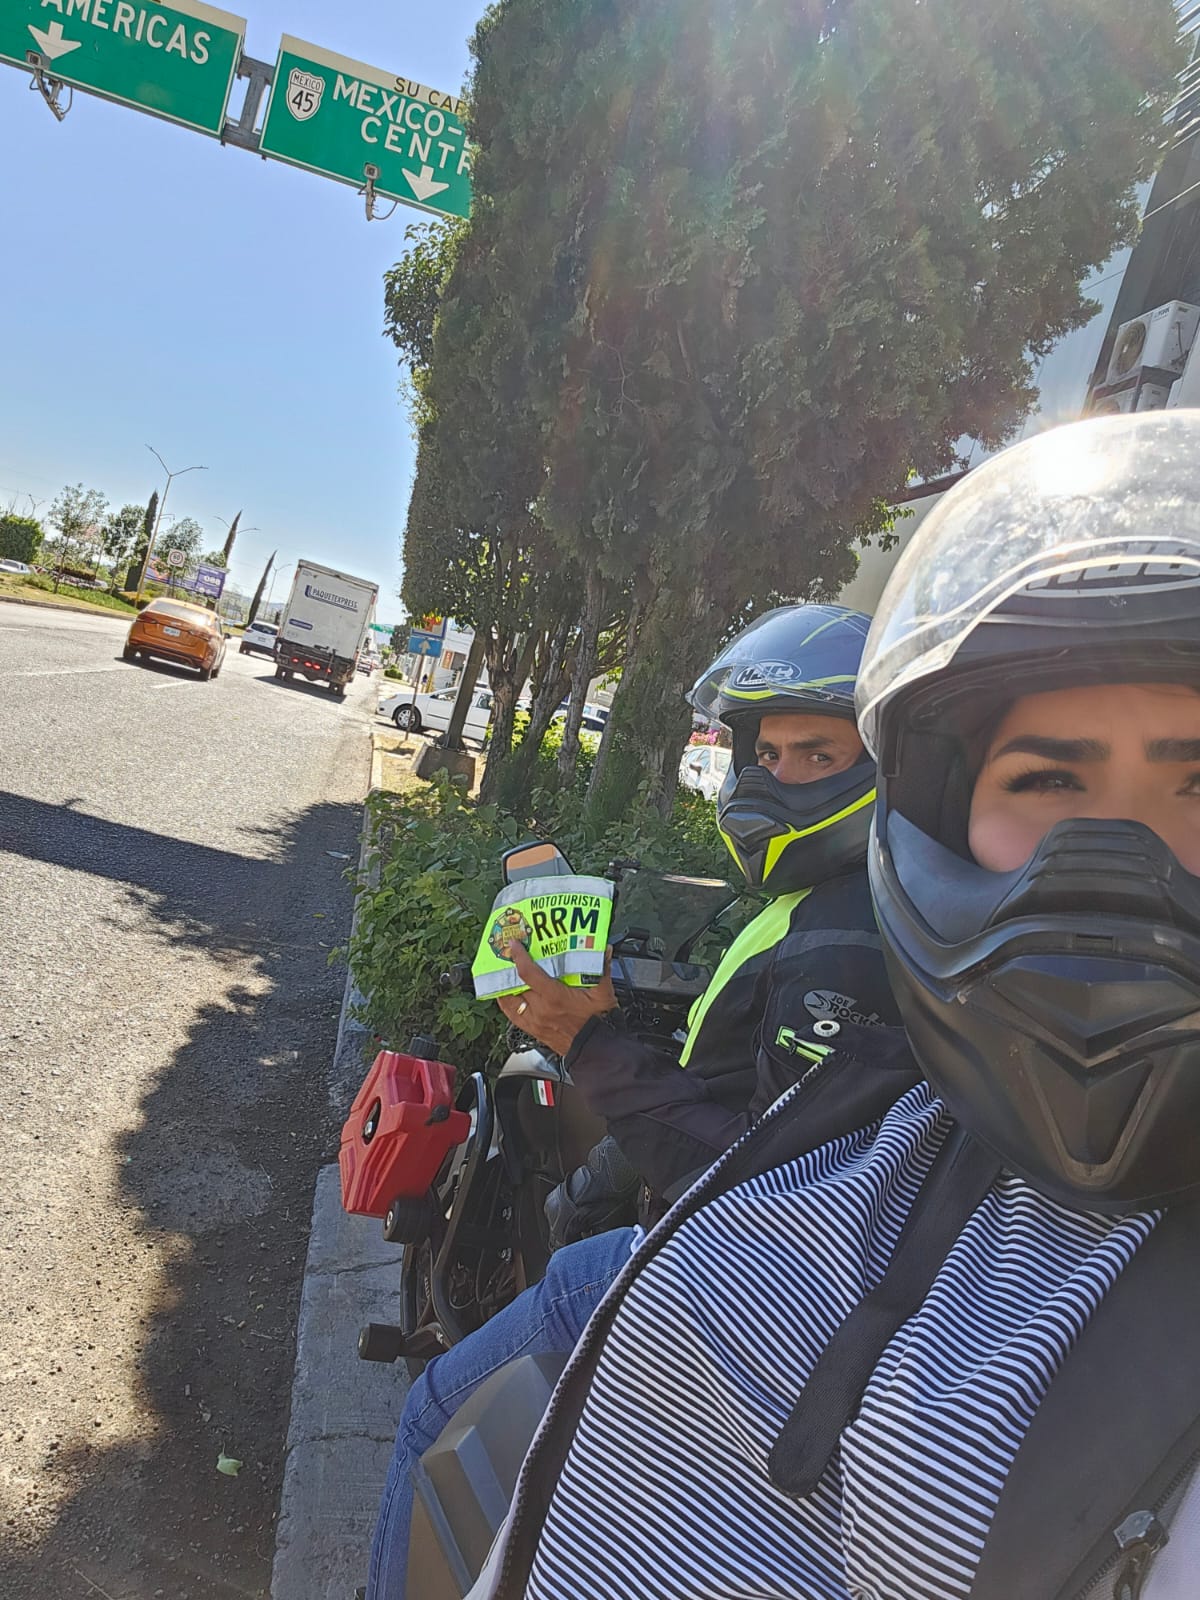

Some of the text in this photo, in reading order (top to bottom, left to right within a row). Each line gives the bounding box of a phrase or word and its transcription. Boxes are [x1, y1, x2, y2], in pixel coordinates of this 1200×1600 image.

[294, 73, 321, 91] MEXICO
[393, 77, 420, 98] SU
[292, 90, 315, 112] 45
[312, 588, 359, 609] PAQUETEXPRESS
[531, 894, 600, 911] MOTOTURISTA
[532, 907, 599, 941] RRM
[541, 938, 568, 957] MEXICO
[831, 995, 850, 1008] JOE
